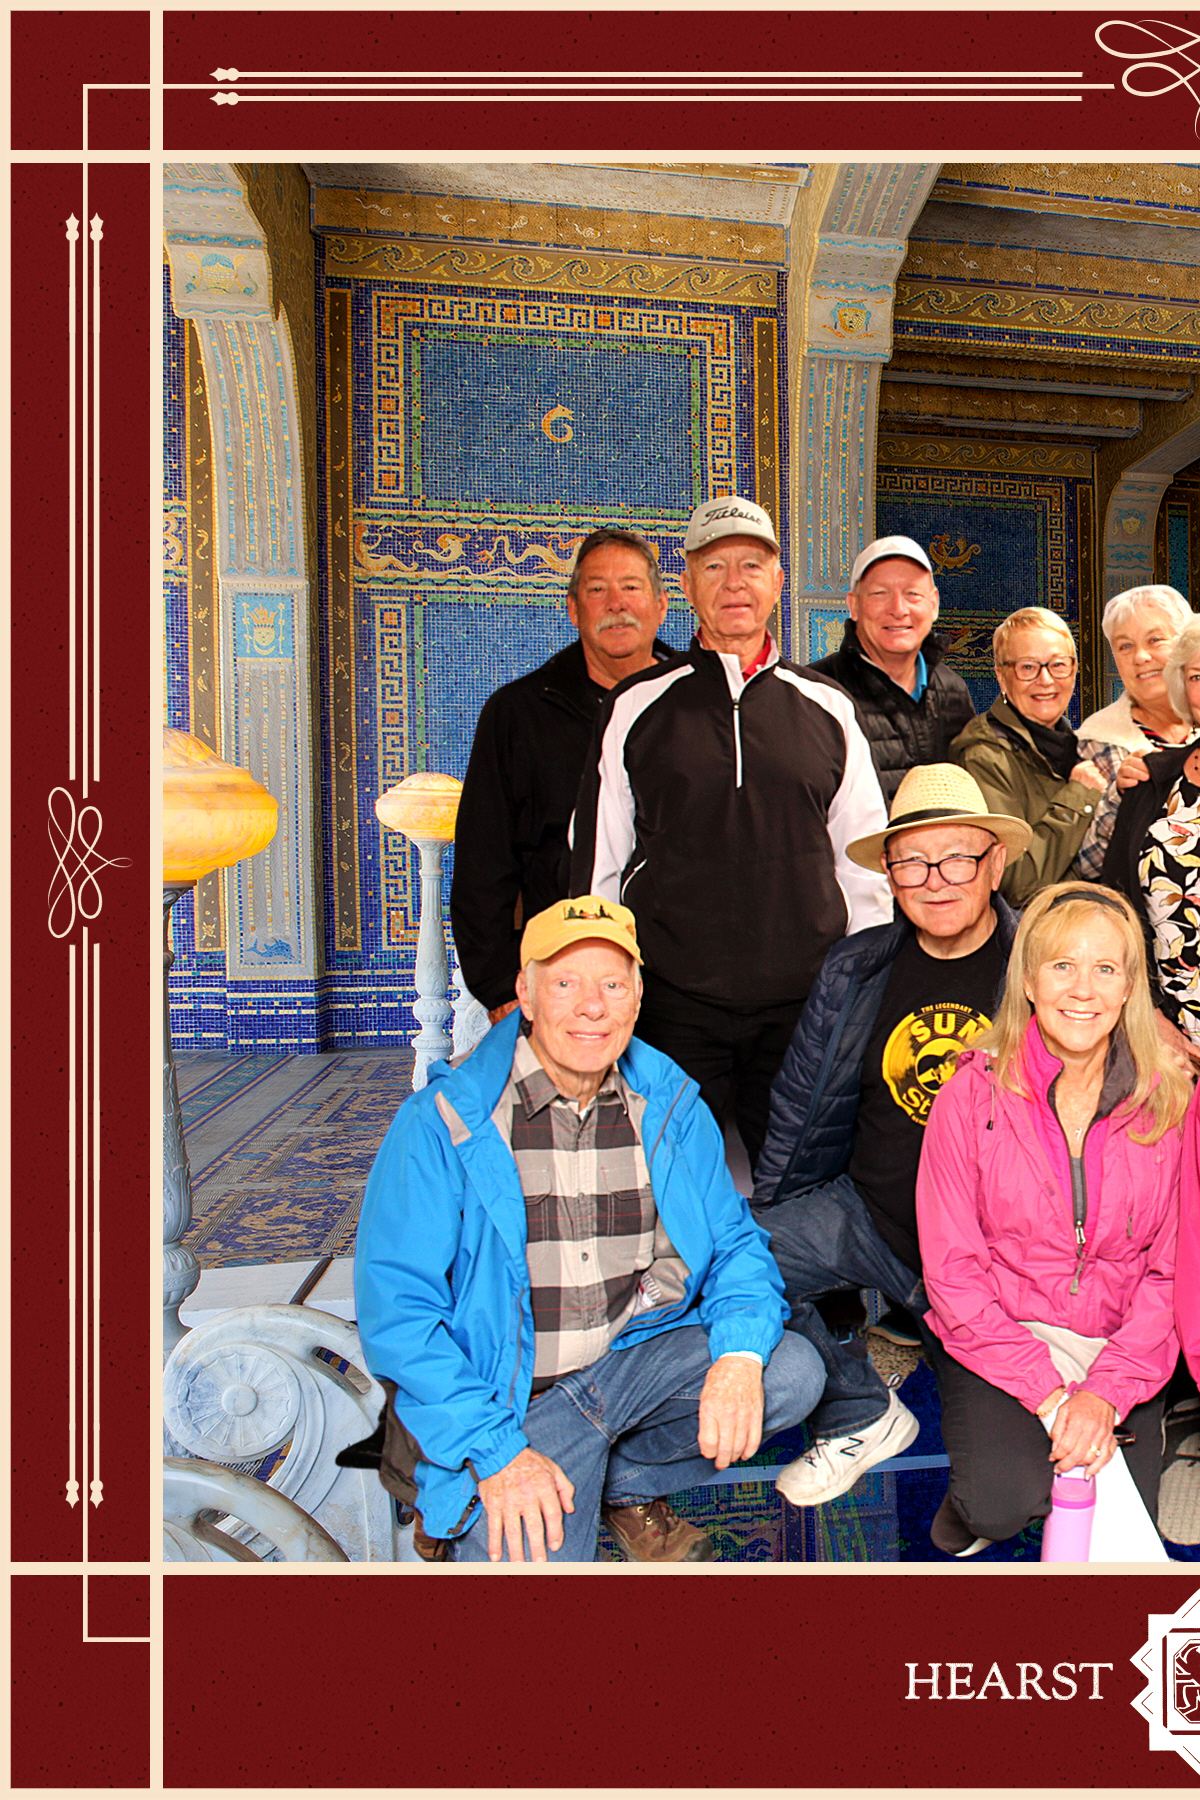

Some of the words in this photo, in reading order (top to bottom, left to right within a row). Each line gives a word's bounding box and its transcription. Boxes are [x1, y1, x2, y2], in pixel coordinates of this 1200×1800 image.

[920, 1004, 934, 1014] THE
[934, 1002, 973, 1014] LEGENDARY
[910, 1012, 985, 1045] SUN
